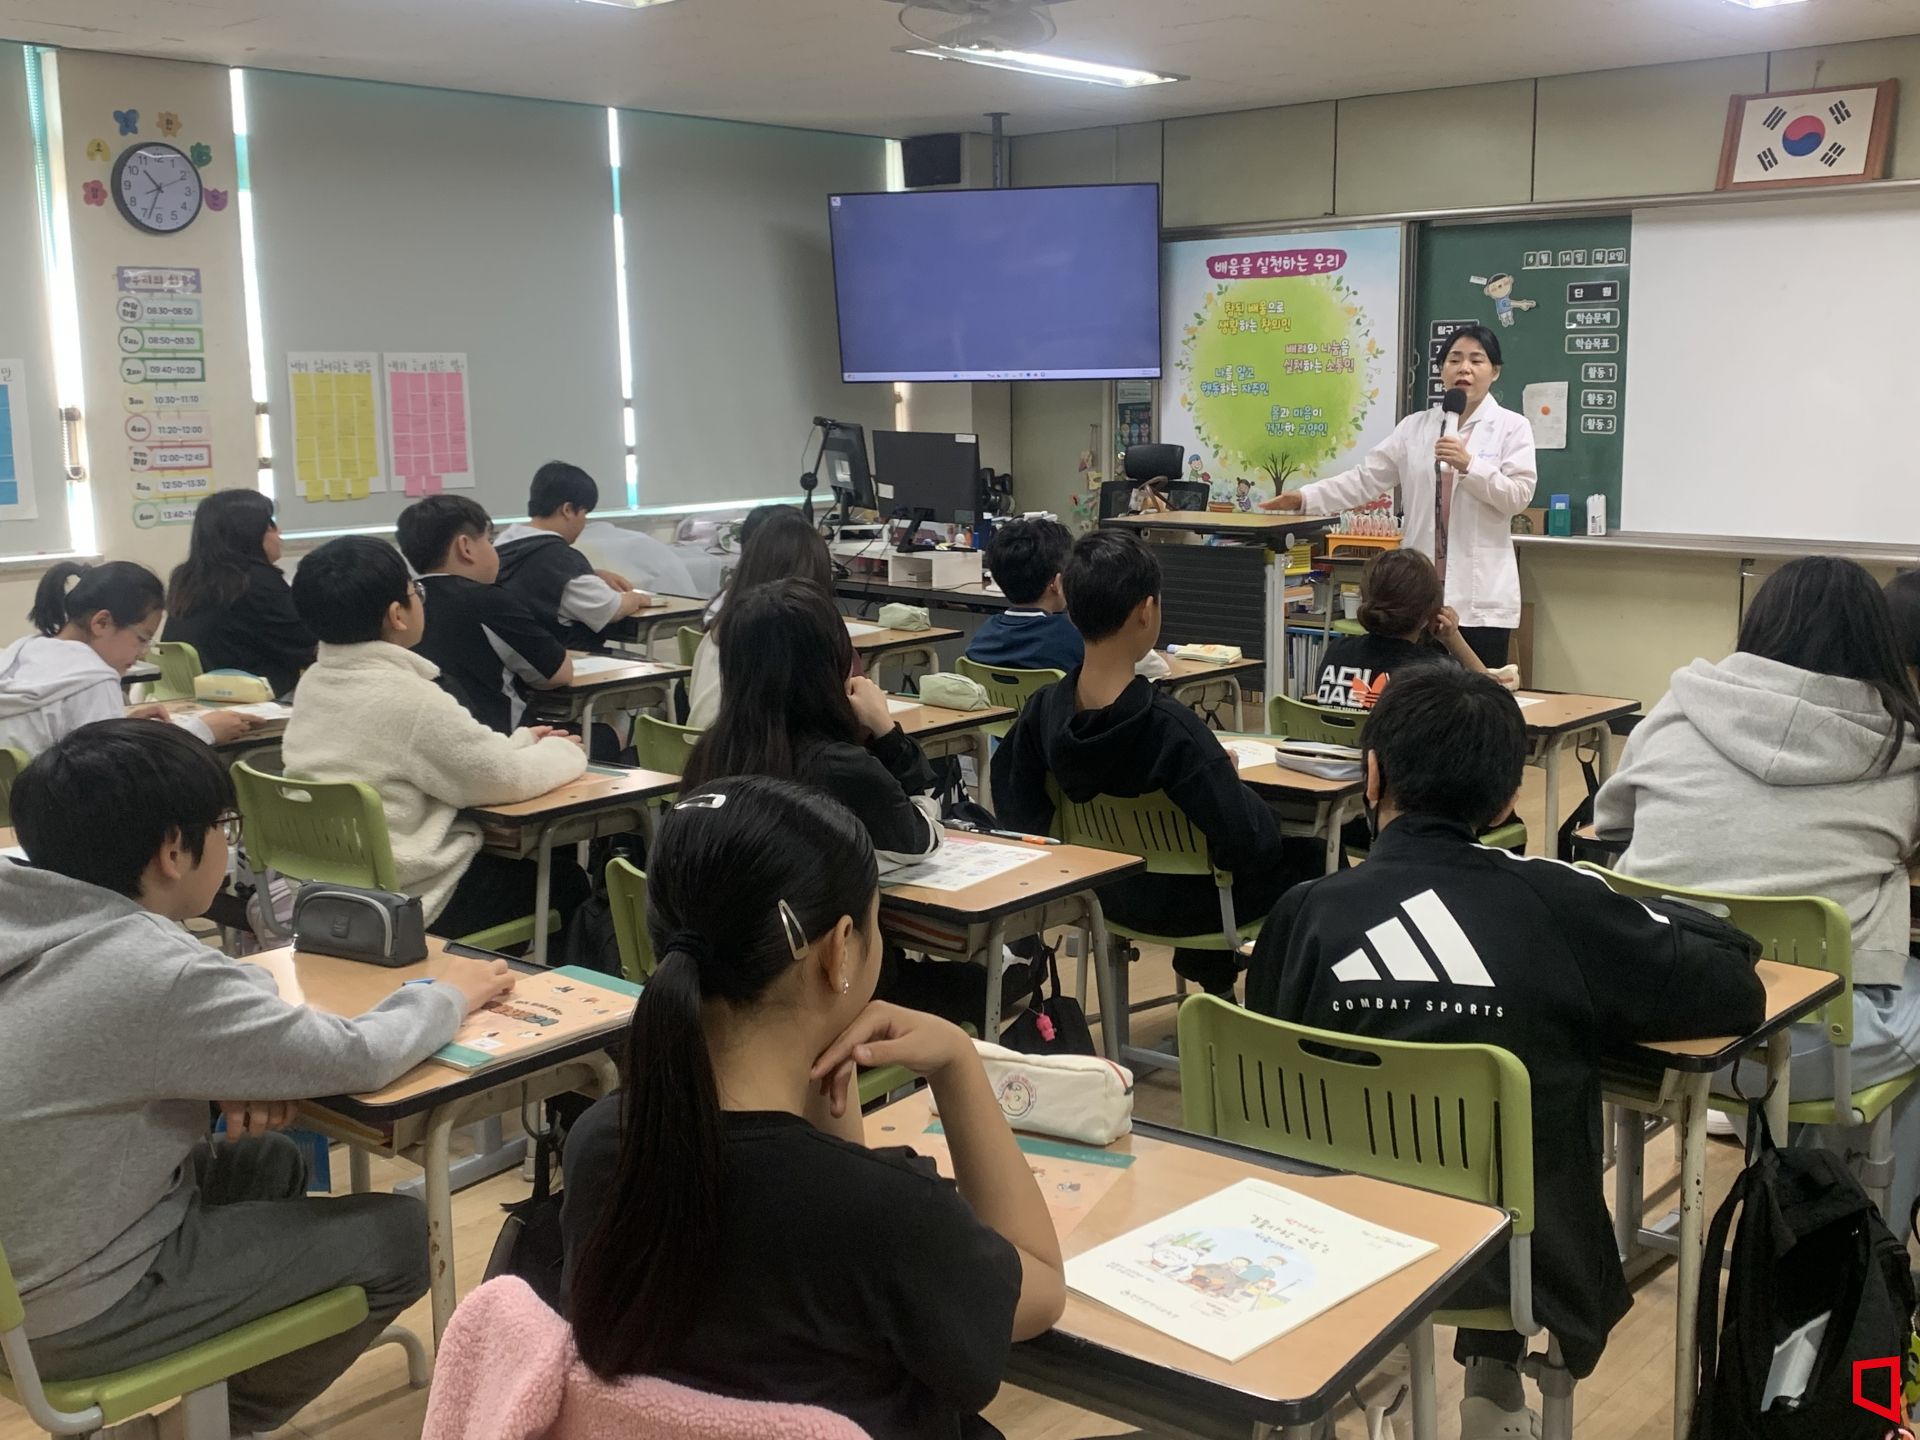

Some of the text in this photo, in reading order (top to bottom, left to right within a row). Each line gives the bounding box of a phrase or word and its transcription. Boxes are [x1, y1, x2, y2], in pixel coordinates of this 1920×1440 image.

[138, 156, 148, 166] 11
[170, 159, 175, 168] 1
[128, 166, 139, 176] 10
[179, 171, 187, 181] 2
[123, 180, 131, 190] 9
[184, 187, 192, 197] 3
[129, 196, 137, 207] 8
[180, 201, 188, 211] 4
[141, 208, 149, 218] 7
[155, 213, 163, 223] 6
[170, 211, 178, 221] 5
[1214, 253, 1340, 276] 배움을 실천하는 우리
[1225, 300, 1285, 317] 참된 배움으로
[1576, 312, 1611, 324] 학습문제
[1218, 317, 1257, 335] 생활하는
[1285, 338, 1350, 356] 배려와 나눔을
[1575, 338, 1610, 350] 학습목표
[1283, 356, 1354, 374] 실천하는 소통인
[1215, 364, 1255, 381] 나를 알고
[1587, 366, 1613, 379] 활동 1
[1201, 381, 1269, 397] 행동하는 자주인
[1587, 393, 1613, 405] 활동 2
[1272, 405, 1322, 421] 몸과 마음이
[1265, 422, 1295, 436] 건강한
[1586, 418, 1613, 430] 활동 3
[1332, 997, 1504, 1018] COMBAT SPORTS
